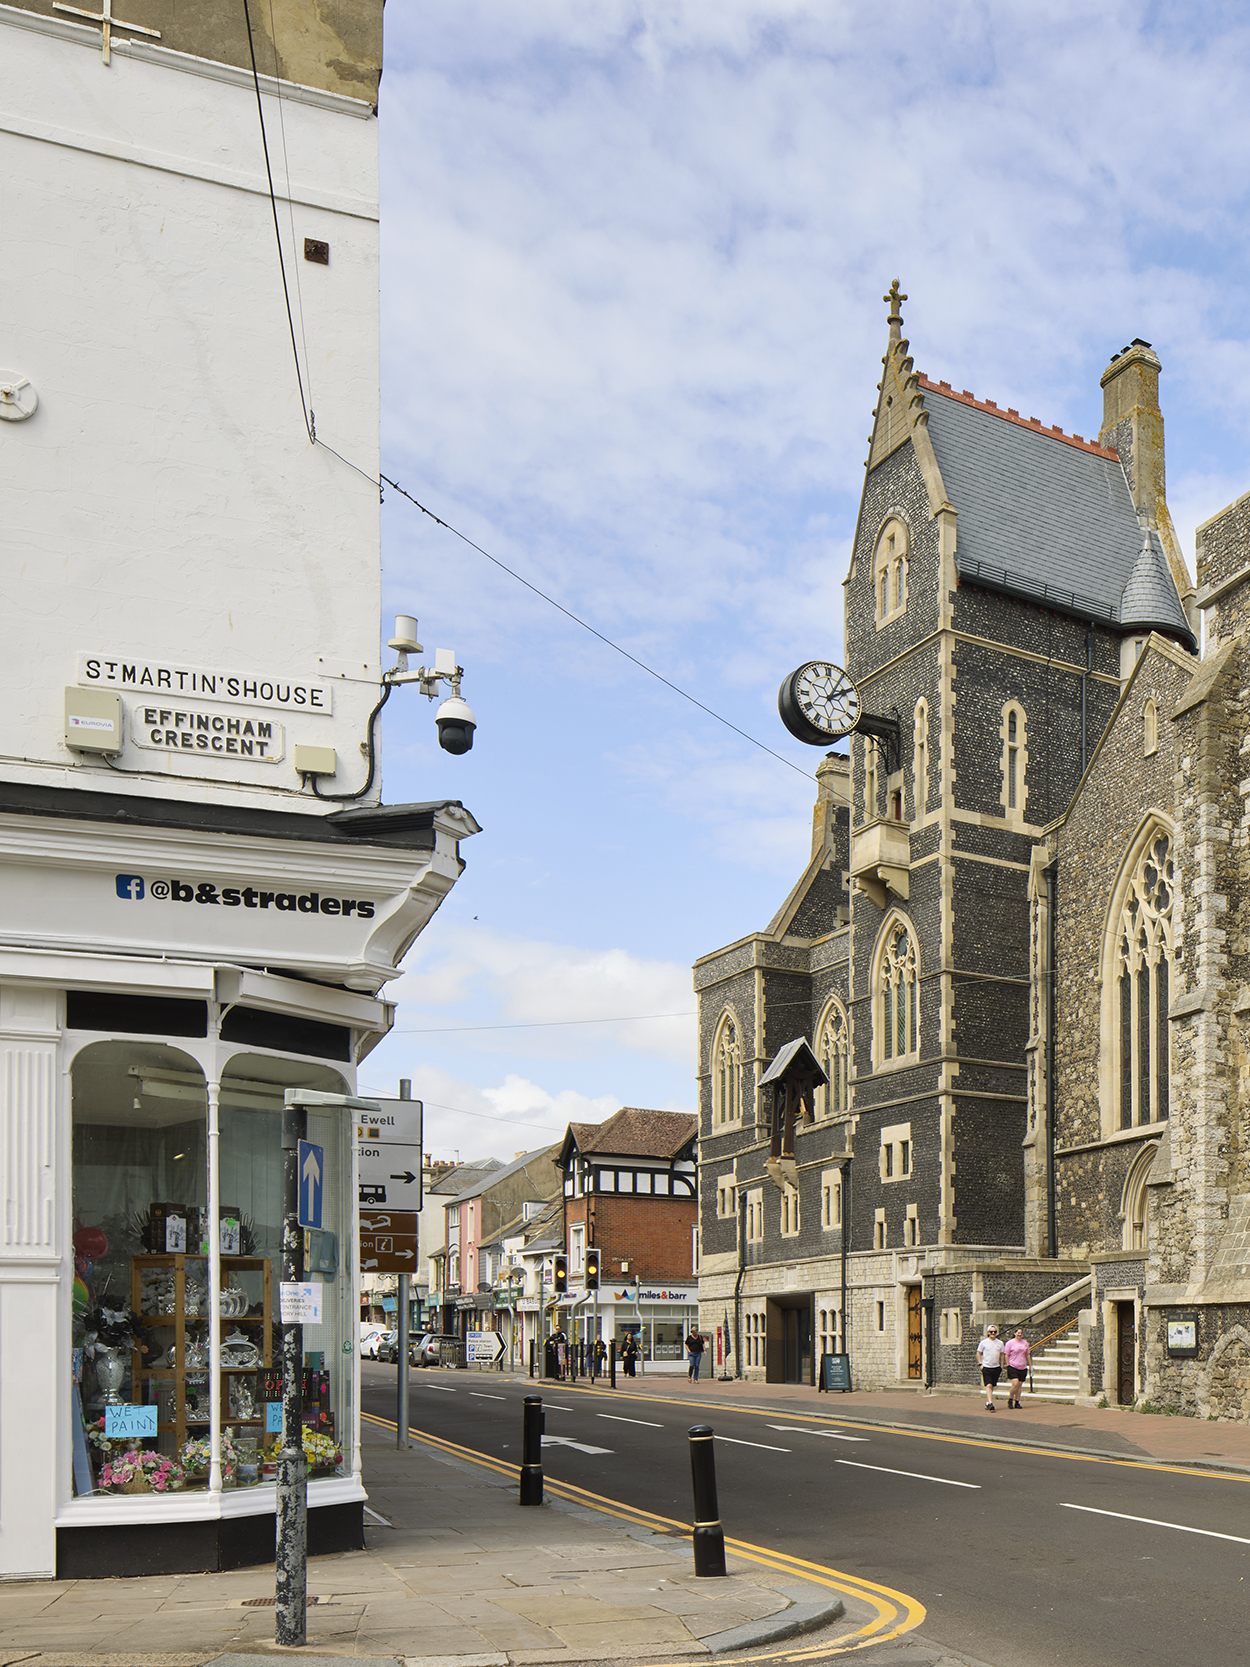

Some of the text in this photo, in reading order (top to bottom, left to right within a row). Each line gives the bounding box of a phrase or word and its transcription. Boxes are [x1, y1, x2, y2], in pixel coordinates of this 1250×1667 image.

[80, 720, 113, 728] EUROVIA
[144, 708, 272, 738] EFFINGHAM
[150, 729, 269, 757] CRESCENT
[150, 879, 375, 919] @b&straders
[361, 1114, 395, 1126] Ewell
[109, 1405, 145, 1418] WET
